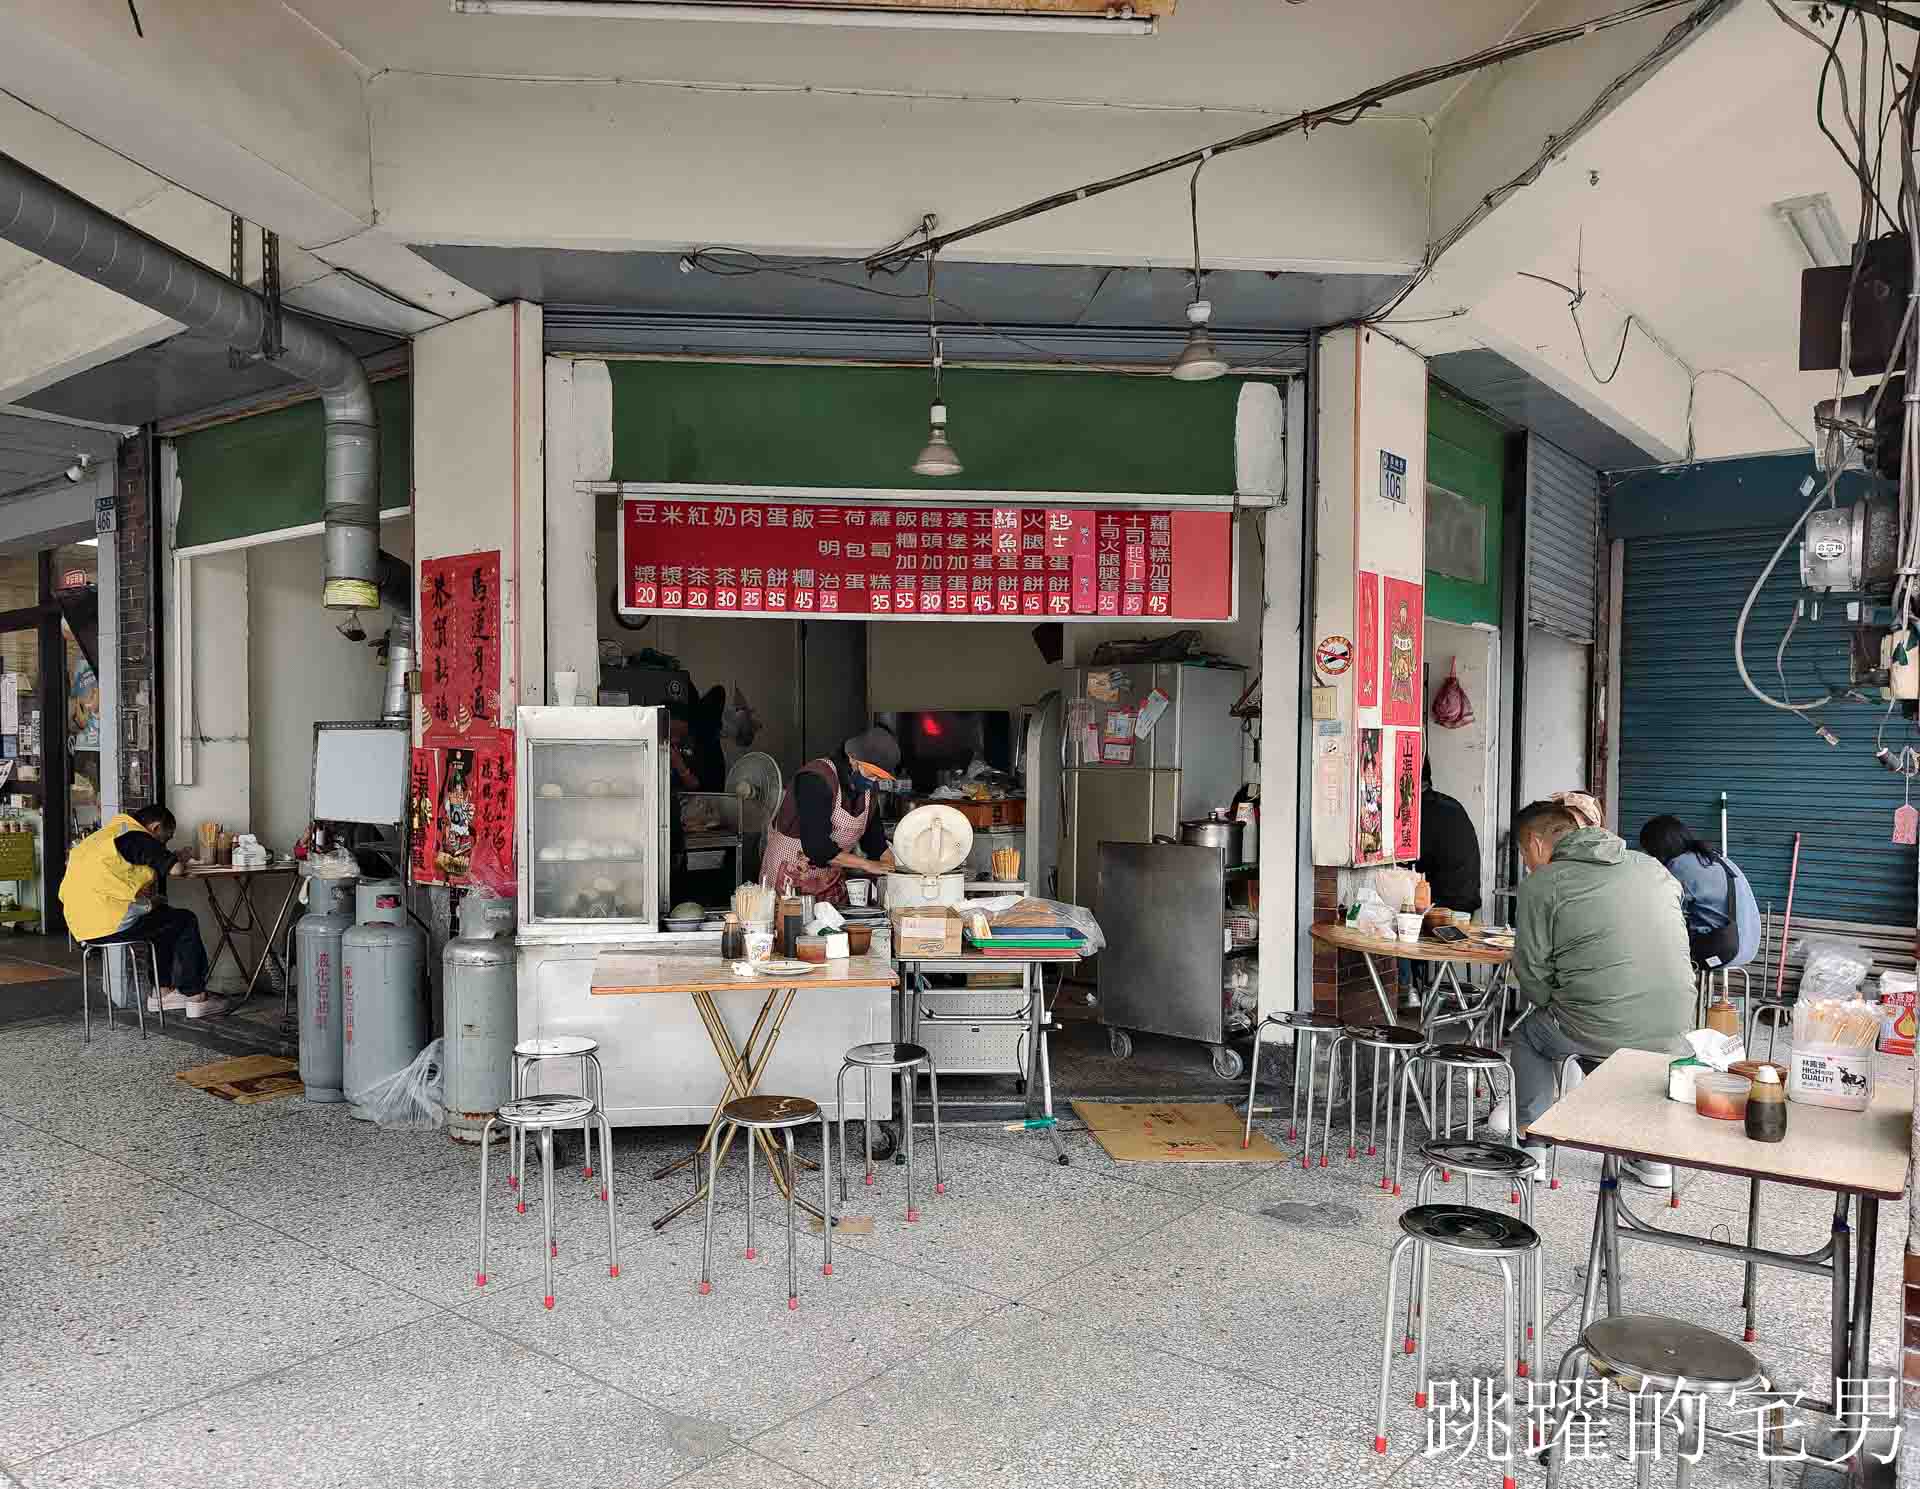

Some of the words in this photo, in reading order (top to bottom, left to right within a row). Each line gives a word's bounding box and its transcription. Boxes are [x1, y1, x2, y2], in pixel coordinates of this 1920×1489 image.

[1386, 471, 1401, 500] 106
[946, 512, 968, 591] 漢堡加蛋
[972, 512, 993, 592] 玉米蛋餅
[1023, 513, 1044, 592] 火腿蛋餅
[636, 587, 656, 603] 20
[663, 590, 682, 604] 20
[688, 591, 707, 606] 20
[717, 591, 737, 607] 30
[743, 591, 760, 606] 35
[767, 591, 785, 607] 35
[795, 591, 814, 608] 45
[821, 594, 837, 608] 25
[871, 594, 890, 610] 35
[896, 593, 914, 609] 55
[922, 594, 941, 610] 30
[949, 595, 966, 609] 35
[974, 595, 992, 611] 45
[999, 595, 1017, 611] 45
[1024, 596, 1040, 610] 45
[1099, 595, 1114, 610] 35
[1049, 595, 1071, 613] 45
[1149, 595, 1167, 612] 45
[1801, 1073, 1834, 1084] QUALITY
[1802, 1066, 1821, 1075] HIGH
